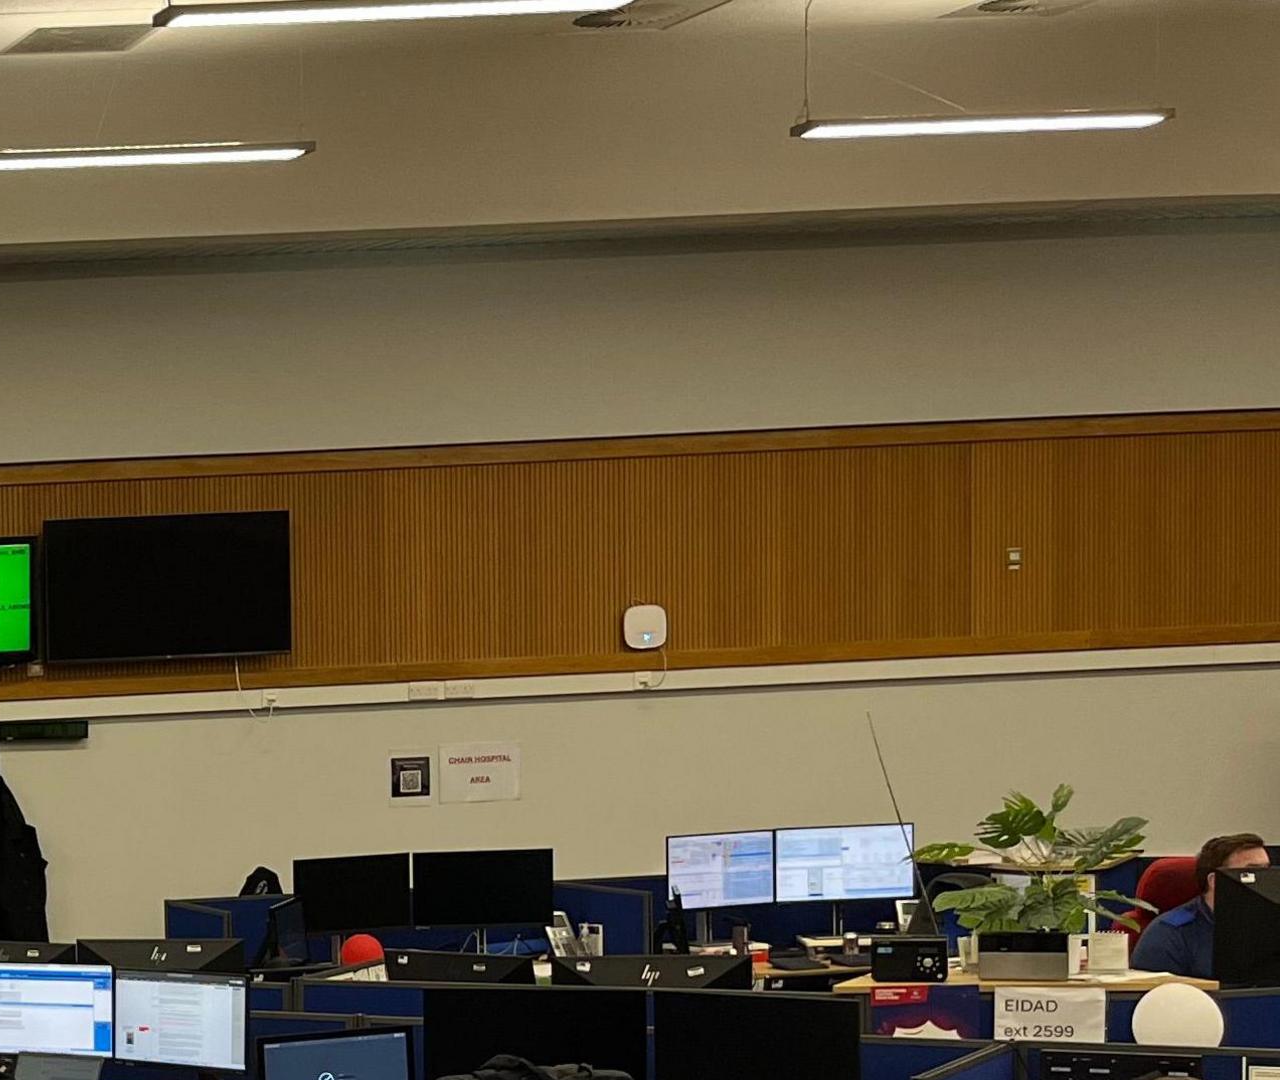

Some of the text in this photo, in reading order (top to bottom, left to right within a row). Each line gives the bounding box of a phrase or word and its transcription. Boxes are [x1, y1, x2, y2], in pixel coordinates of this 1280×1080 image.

[448, 755, 512, 765] CHAIR HOSPITAL
[470, 775, 491, 784] AREA
[642, 964, 660, 986] hp
[1004, 999, 1058, 1013] EIDAD
[1004, 1025, 1074, 1038] ext 2599
